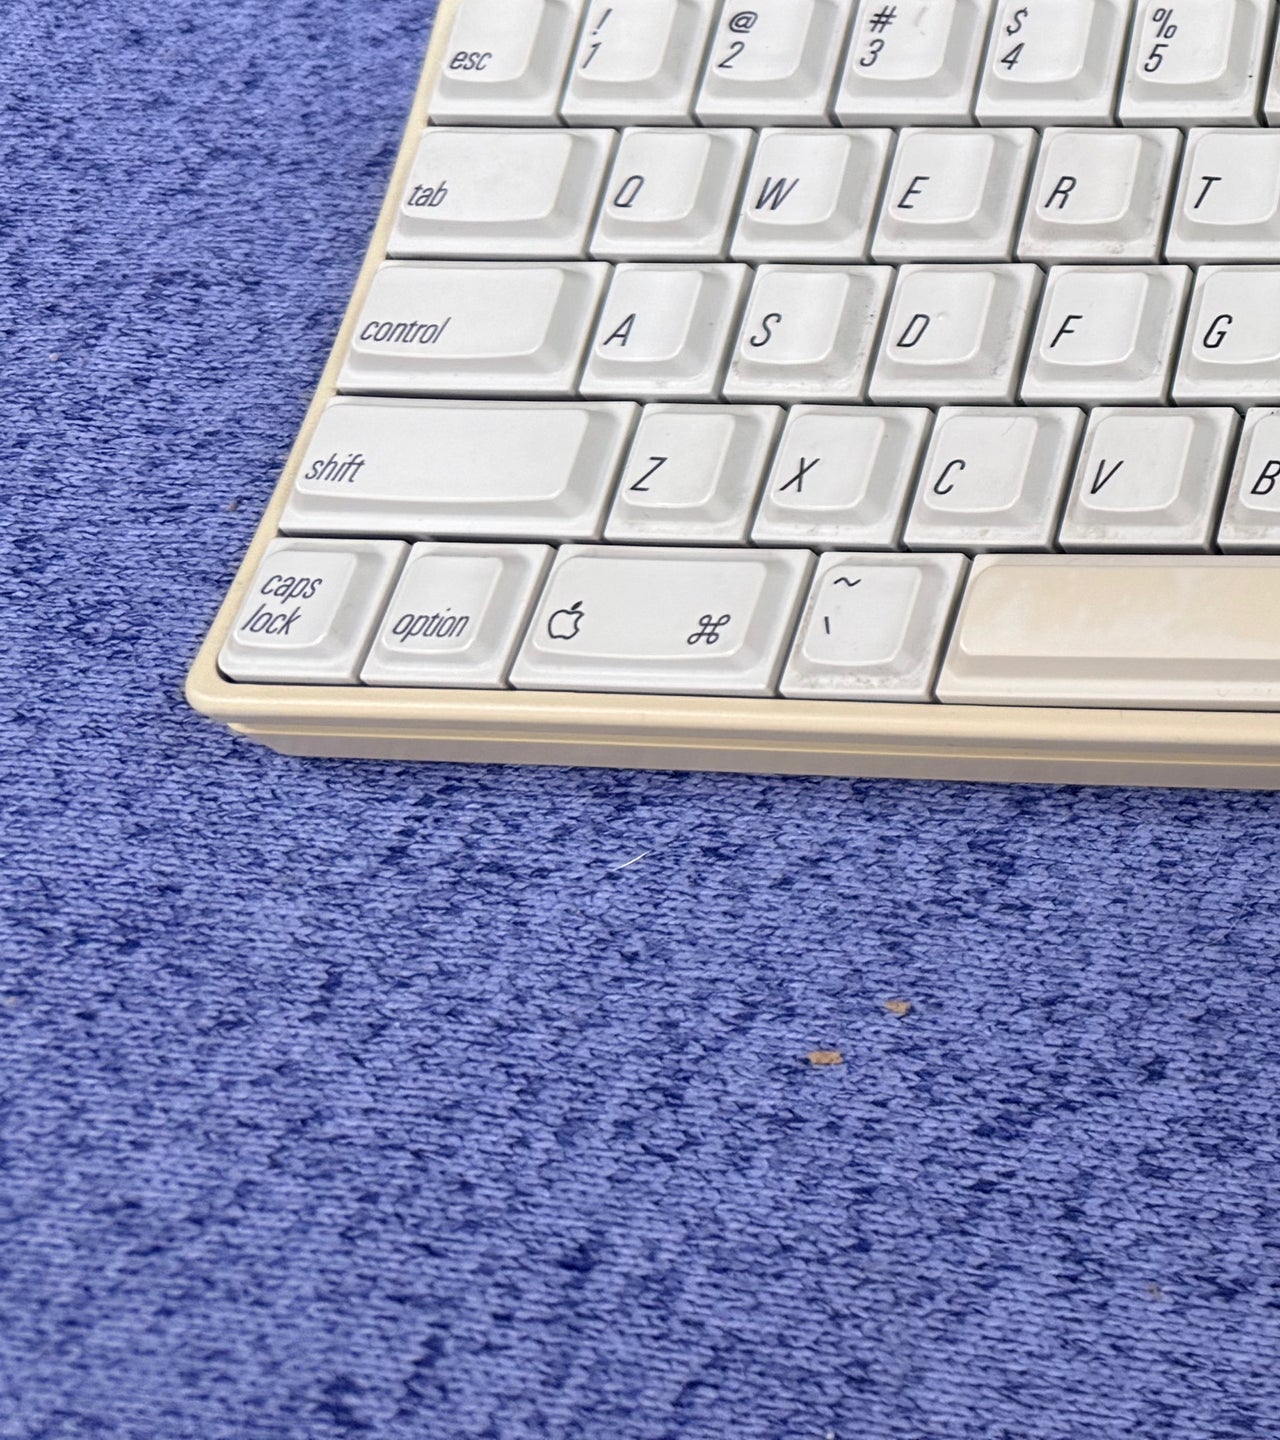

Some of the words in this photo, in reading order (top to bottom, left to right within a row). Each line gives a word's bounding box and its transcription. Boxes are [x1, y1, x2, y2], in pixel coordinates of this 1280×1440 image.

[591, 6, 612, 37] !
[727, 10, 759, 34] @
[869, 5, 897, 34] #
[1006, 7, 1029, 37] $
[1151, 7, 1178, 40] %
[448, 50, 493, 71] esc
[581, 41, 602, 69] 1
[717, 40, 744, 69] 2
[859, 38, 885, 67] 3
[1000, 42, 1025, 71] 4
[1143, 43, 1169, 73] 5
[407, 180, 448, 208] tab
[613, 174, 645, 208] Q
[754, 176, 800, 211] W
[896, 175, 928, 209] E
[1044, 175, 1077, 210] R
[1193, 175, 1222, 209] T
[359, 316, 452, 345] control
[602, 311, 634, 348] A
[749, 312, 782, 348] S
[895, 313, 930, 348] D
[1049, 314, 1083, 348] F
[1202, 313, 1233, 349] G
[304, 452, 366, 483] shift
[629, 456, 668, 492] Z
[778, 456, 821, 493] X
[933, 459, 966, 496] C
[1090, 459, 1124, 495] V
[260, 574, 323, 603] caps
[240, 603, 302, 636] lock
[391, 612, 470, 643] option
